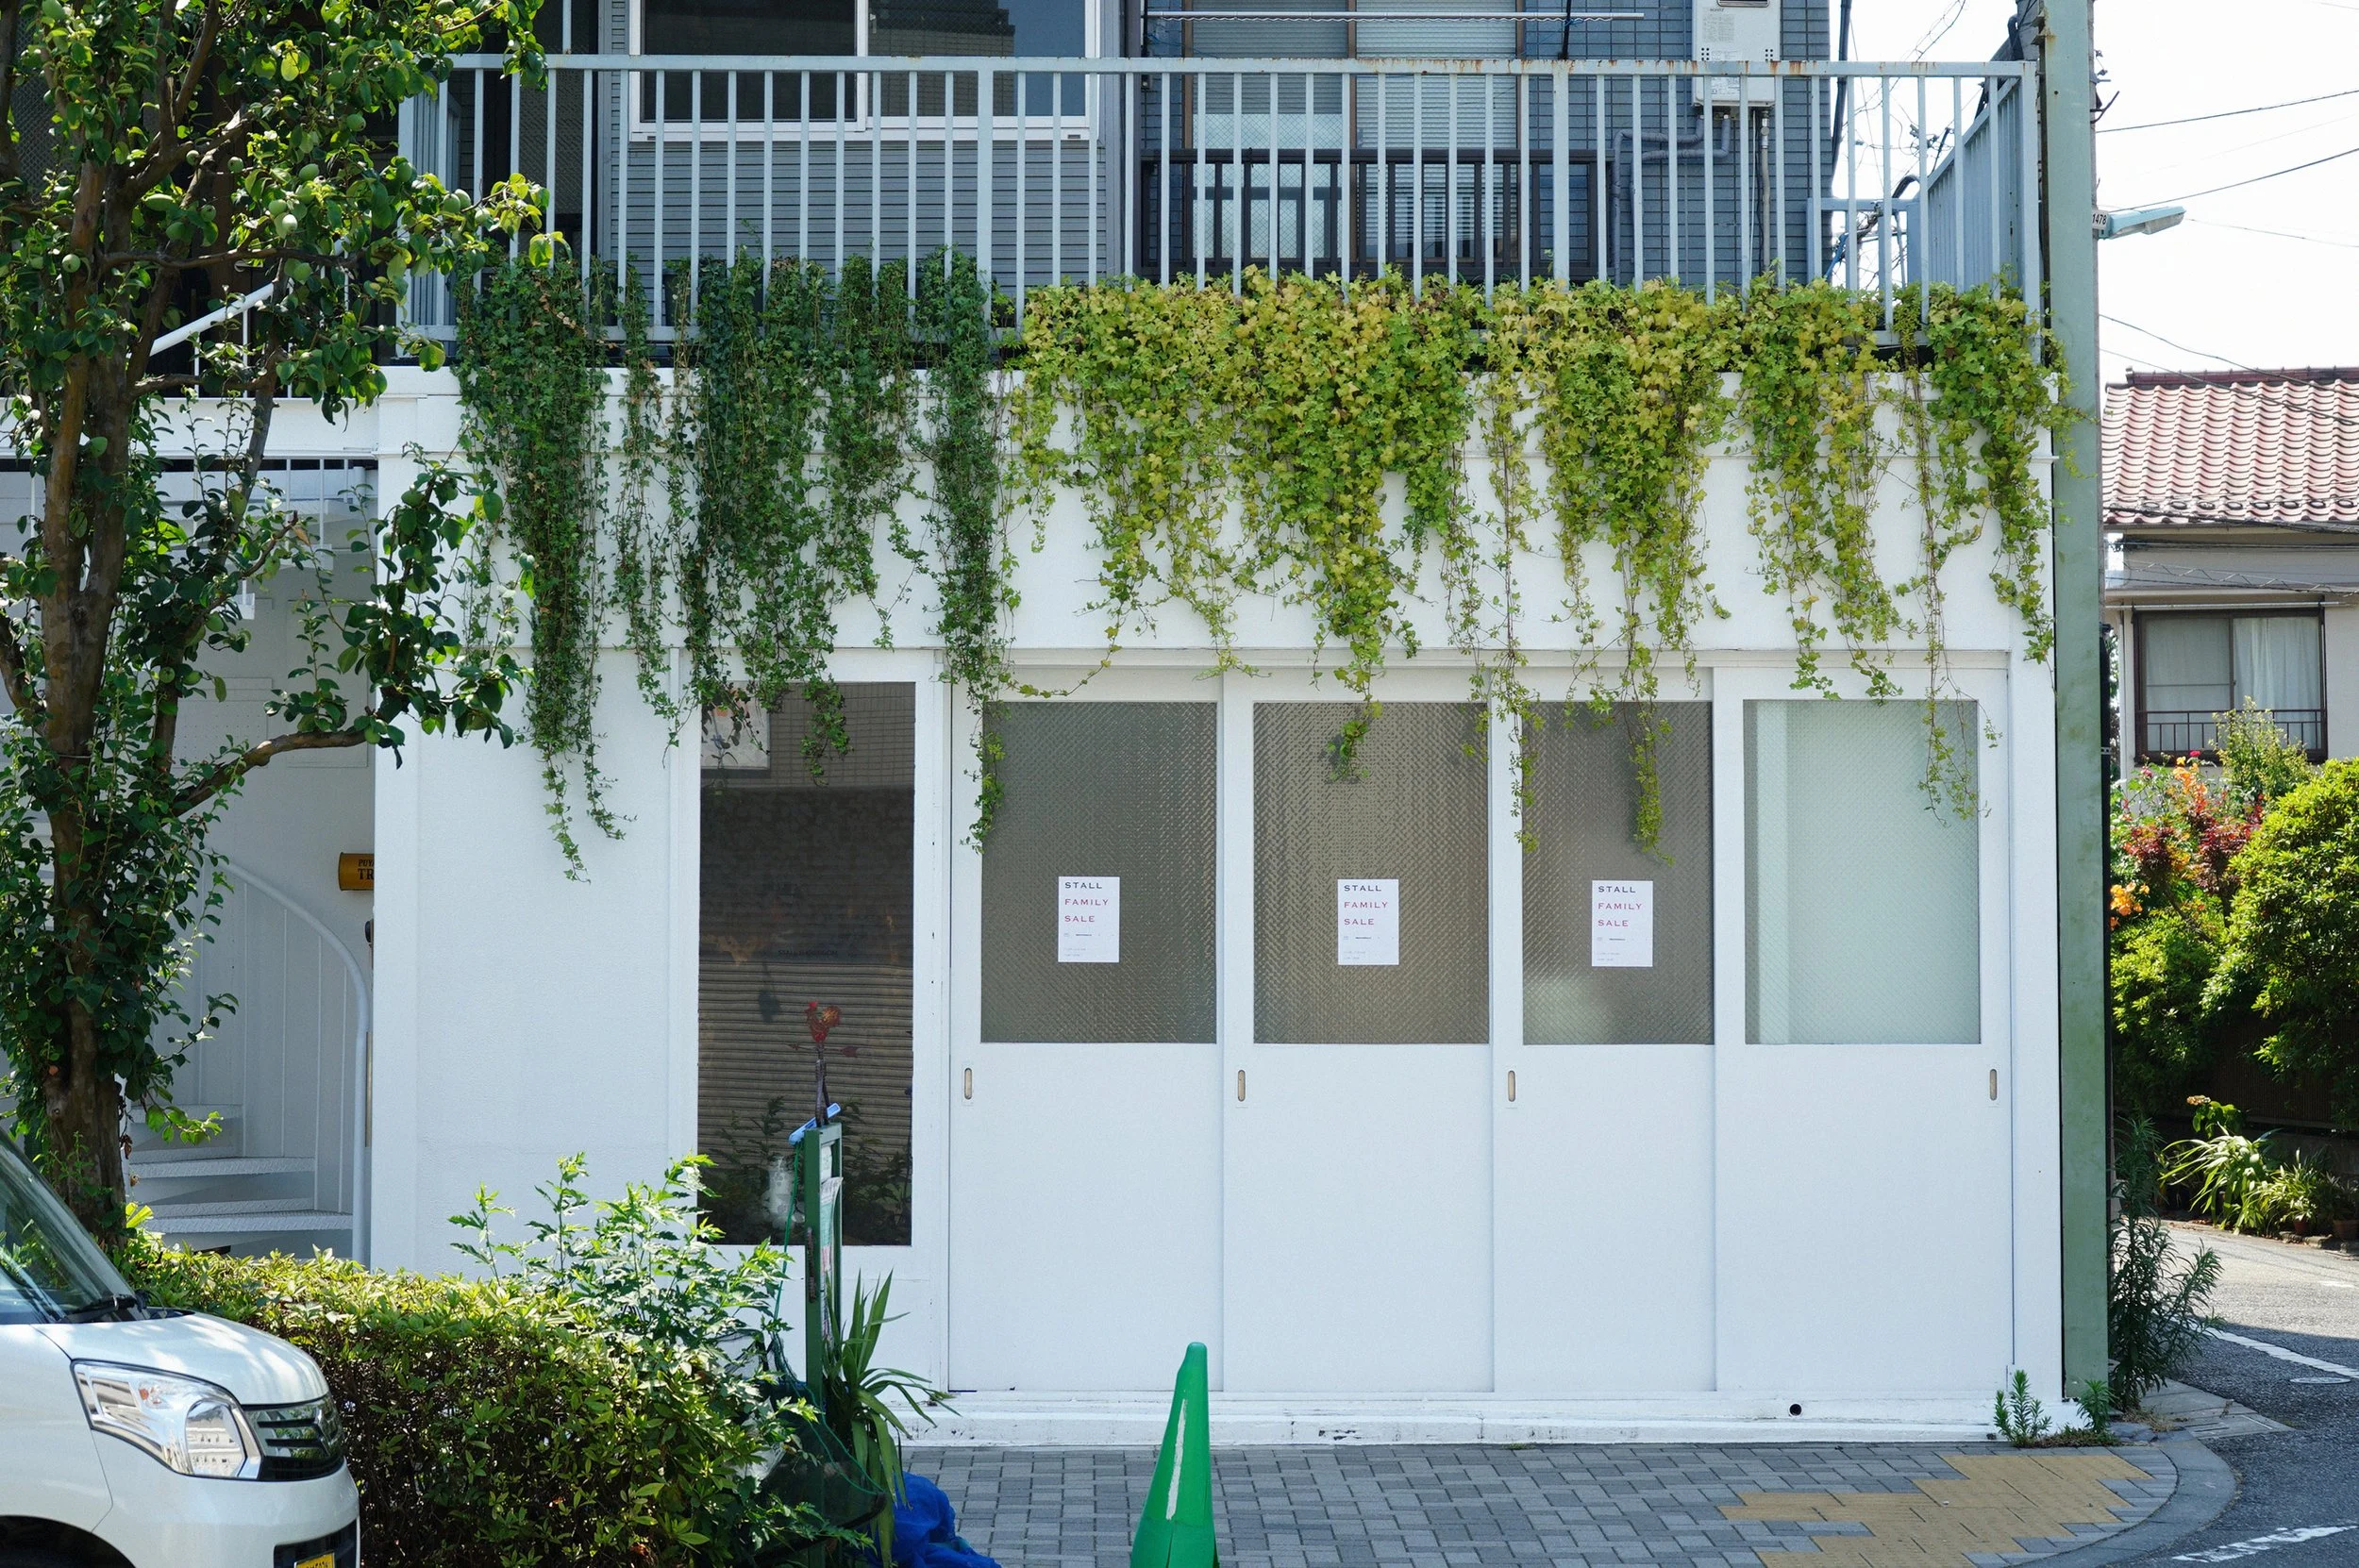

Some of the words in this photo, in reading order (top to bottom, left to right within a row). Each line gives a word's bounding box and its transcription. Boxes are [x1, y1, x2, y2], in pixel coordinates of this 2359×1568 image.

[2092, 213, 2106, 225] 1478
[1064, 881, 1103, 890] STALL
[1344, 884, 1382, 892] STALL
[1598, 885, 1636, 893] STALL
